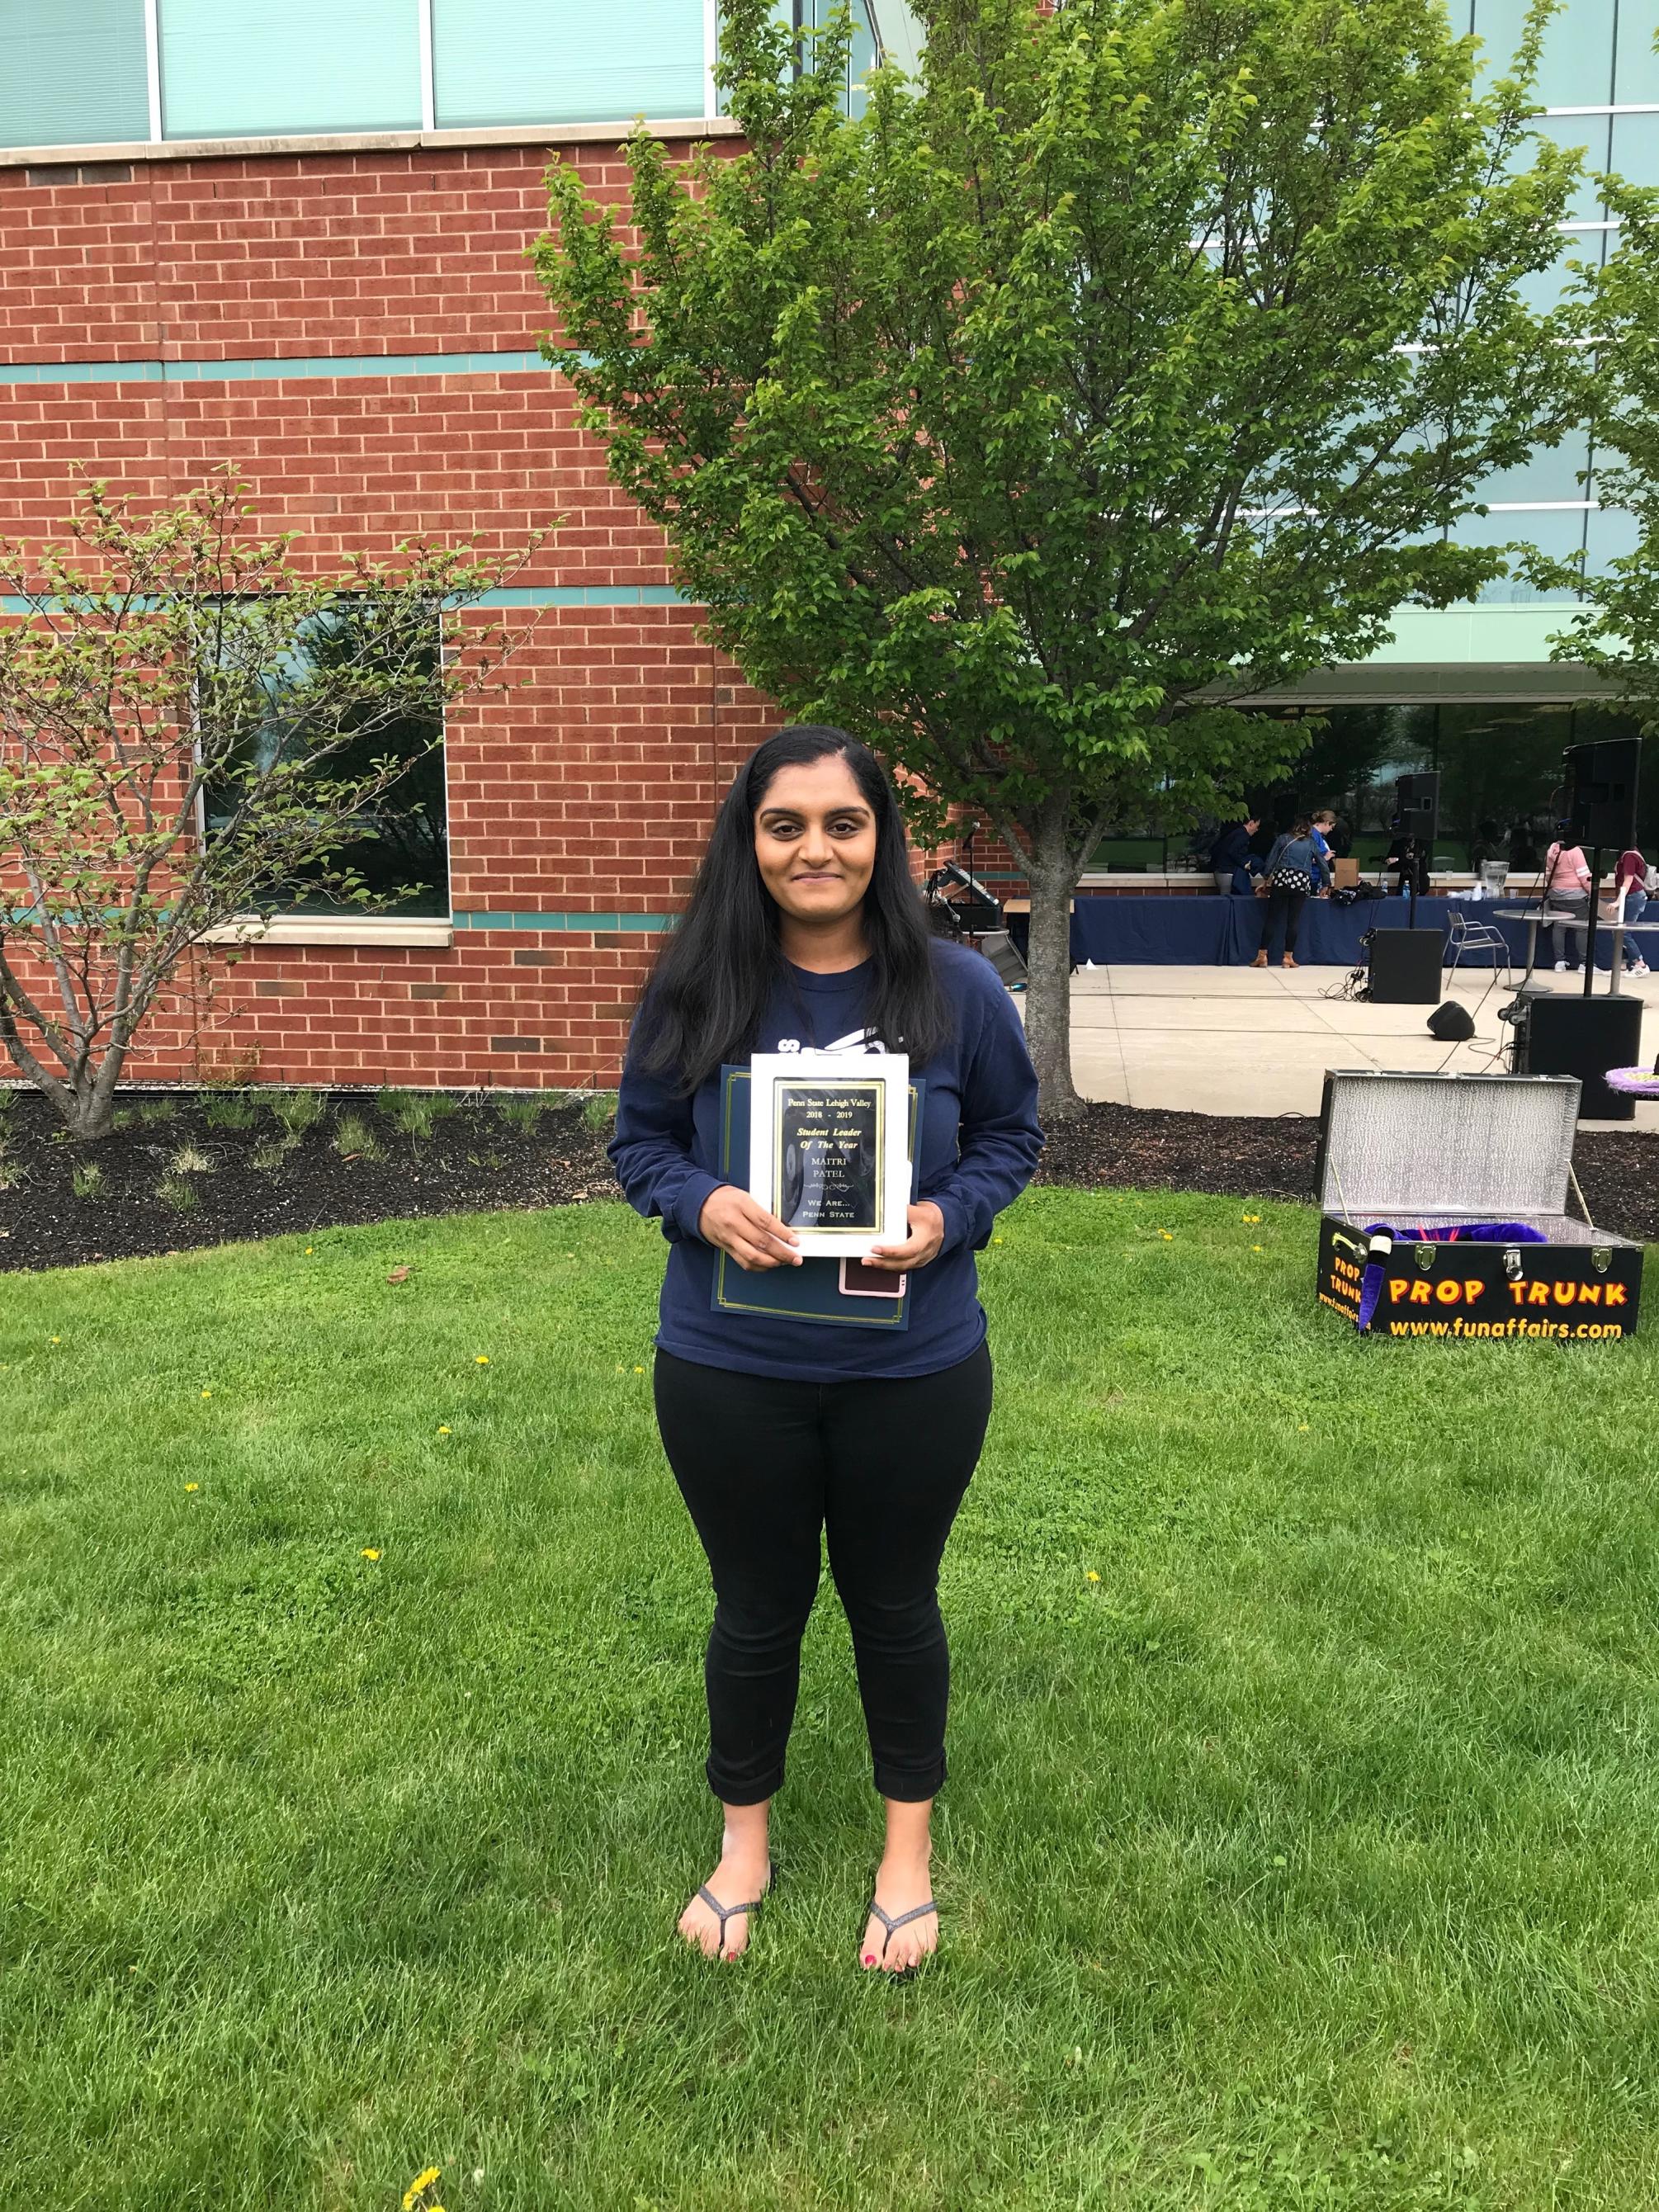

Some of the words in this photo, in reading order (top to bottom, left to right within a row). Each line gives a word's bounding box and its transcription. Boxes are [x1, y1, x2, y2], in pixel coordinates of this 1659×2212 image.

[788, 1099, 805, 1107] Penn
[807, 1099, 824, 1107] State
[826, 1099, 848, 1108] Lehigh
[850, 1099, 871, 1108] Valley
[796, 1128, 829, 1137] Student
[833, 1128, 862, 1137] Leader
[800, 1140, 813, 1150] Of
[818, 1141, 834, 1149] The
[839, 1141, 858, 1149] Year
[1335, 1257, 1360, 1281] PROP
[1330, 1274, 1362, 1304] TRUNK
[1389, 1279, 1485, 1305] PROP
[1509, 1280, 1628, 1306] TRUNK
[1390, 1317, 1622, 1339] www.funaffairs.com
